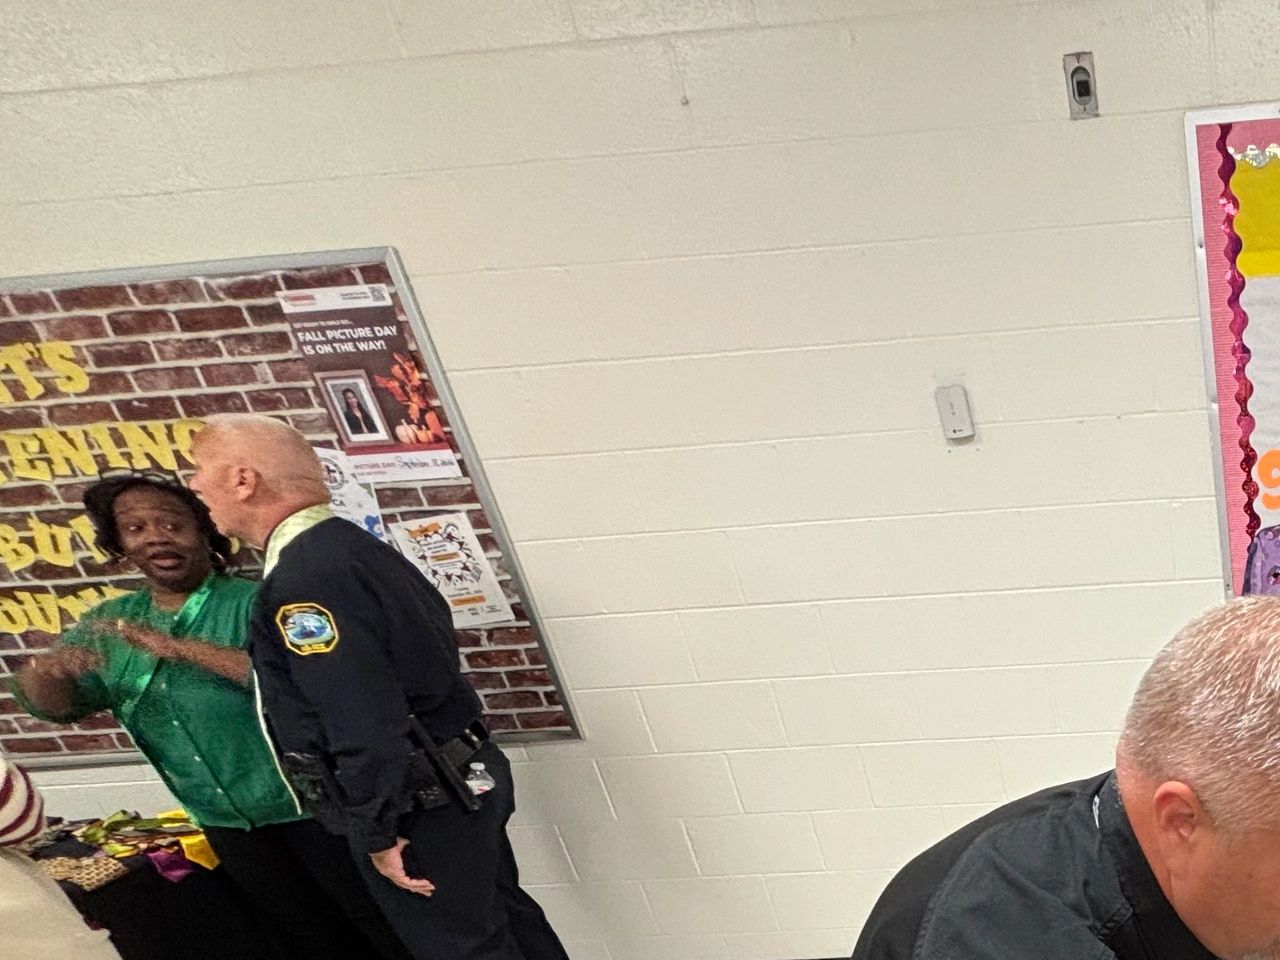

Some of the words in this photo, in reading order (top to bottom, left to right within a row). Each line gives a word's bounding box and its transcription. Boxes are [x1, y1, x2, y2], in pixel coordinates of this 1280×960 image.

[297, 330, 326, 343] FALL
[327, 326, 373, 341] PICTURE
[375, 325, 398, 337] DAY
[303, 344, 313, 355] IS
[315, 342, 333, 354] ON
[334, 340, 355, 353] THE
[357, 339, 387, 351] WAY!
[0, 341, 90, 400] T'S
[0, 418, 206, 481] ENIN
